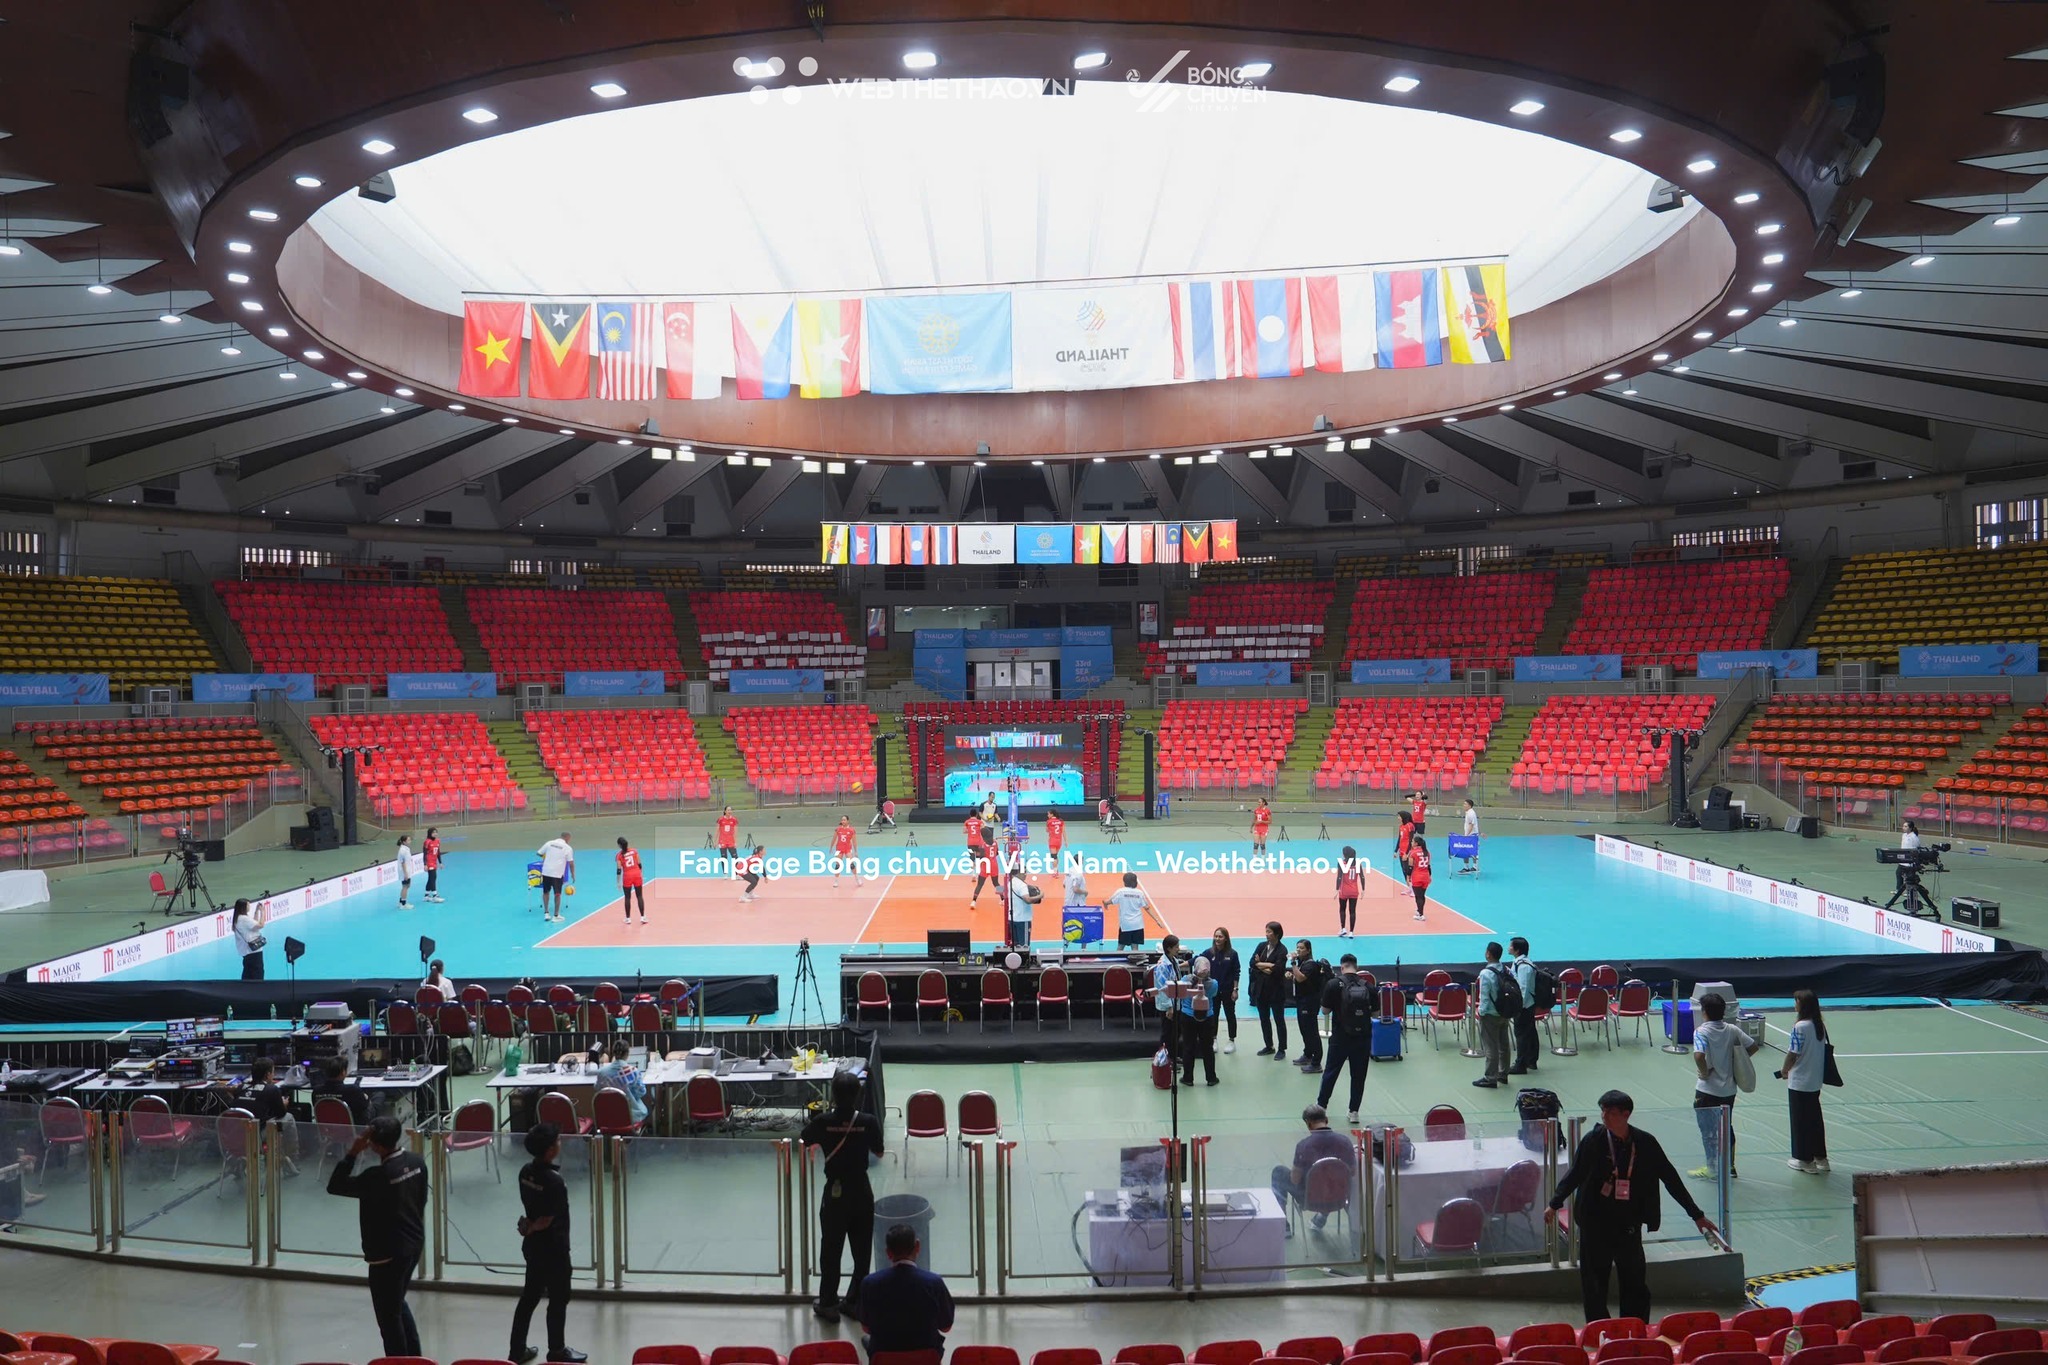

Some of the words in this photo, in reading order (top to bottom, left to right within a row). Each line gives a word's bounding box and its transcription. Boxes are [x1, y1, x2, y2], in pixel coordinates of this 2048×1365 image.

[1933, 655, 1981, 664] THAILAND
[1369, 668, 1414, 676] VOLLEYBALL
[407, 682, 458, 690] VOLLEYBALL
[1418, 856, 1429, 867] 22
[1735, 876, 1752, 887] MAJOR
[1779, 888, 1798, 900] MAJOR
[1828, 901, 1849, 915] MAJOR
[1827, 911, 1849, 923] GROUP
[1887, 918, 1911, 932] MAJOR
[177, 927, 198, 940] MAJOR
[1887, 929, 1912, 941] GROUP
[177, 937, 199, 948] GROUP
[1955, 936, 1984, 951] MAJOR
[116, 944, 141, 958] MAJOR
[117, 954, 142, 967] GROUP
[53, 962, 81, 978] MAJOR
[54, 973, 82, 983] ROUP
